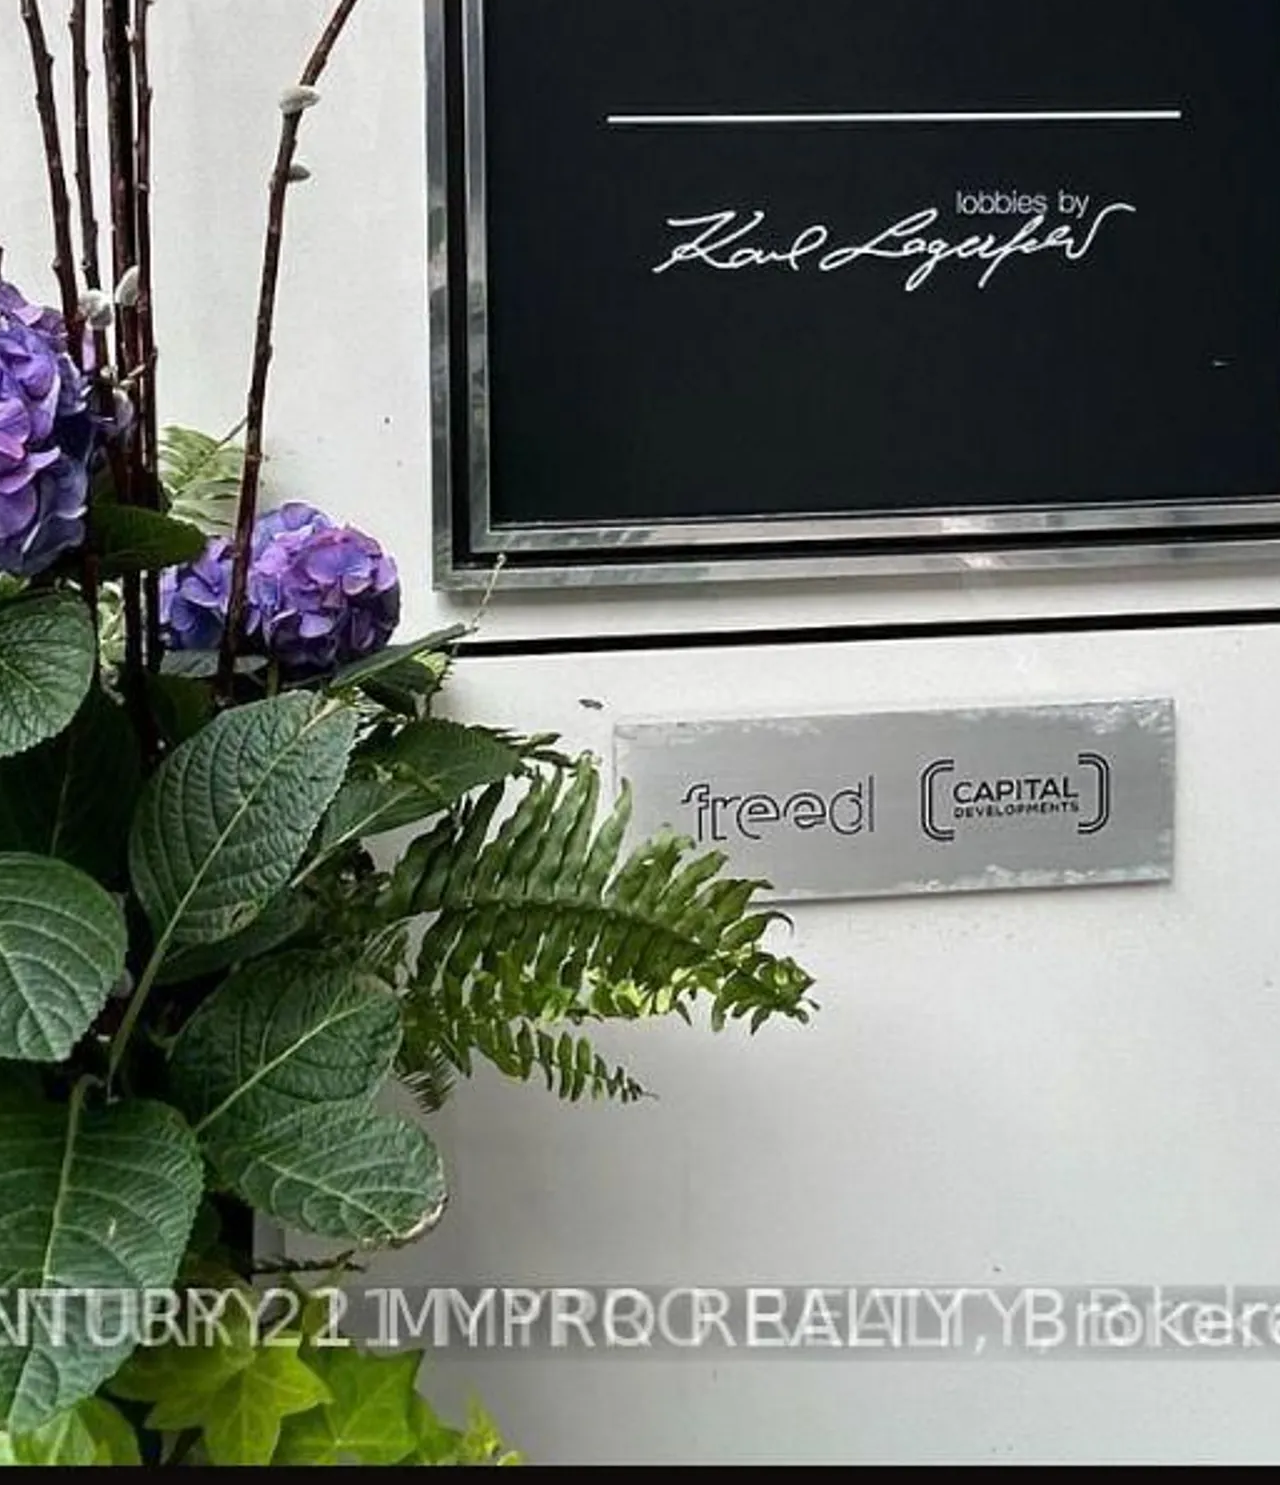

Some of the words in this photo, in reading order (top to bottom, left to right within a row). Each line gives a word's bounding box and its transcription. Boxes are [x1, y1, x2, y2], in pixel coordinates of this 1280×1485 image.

[955, 190, 1047, 215] lobbies
[1058, 190, 1090, 218] by
[652, 210, 828, 273] Karl
[680, 774, 876, 843] freed
[951, 777, 1081, 804] CAPITAL
